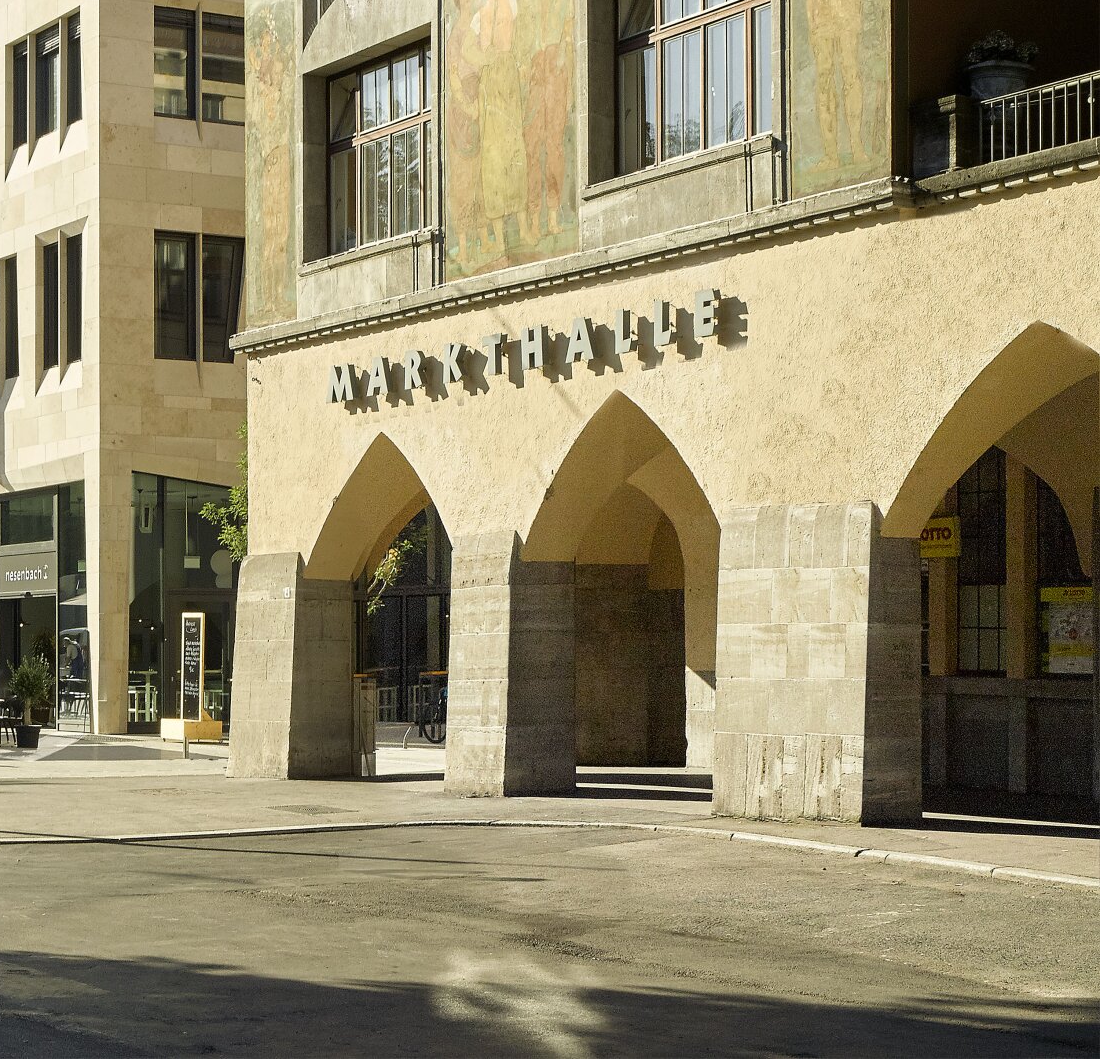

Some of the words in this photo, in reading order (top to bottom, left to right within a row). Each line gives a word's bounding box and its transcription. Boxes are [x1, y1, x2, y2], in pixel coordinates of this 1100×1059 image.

[326, 288, 720, 404] MARKTHALLE
[921, 527, 951, 541] OTTO
[5, 566, 41, 581] nesenbach
